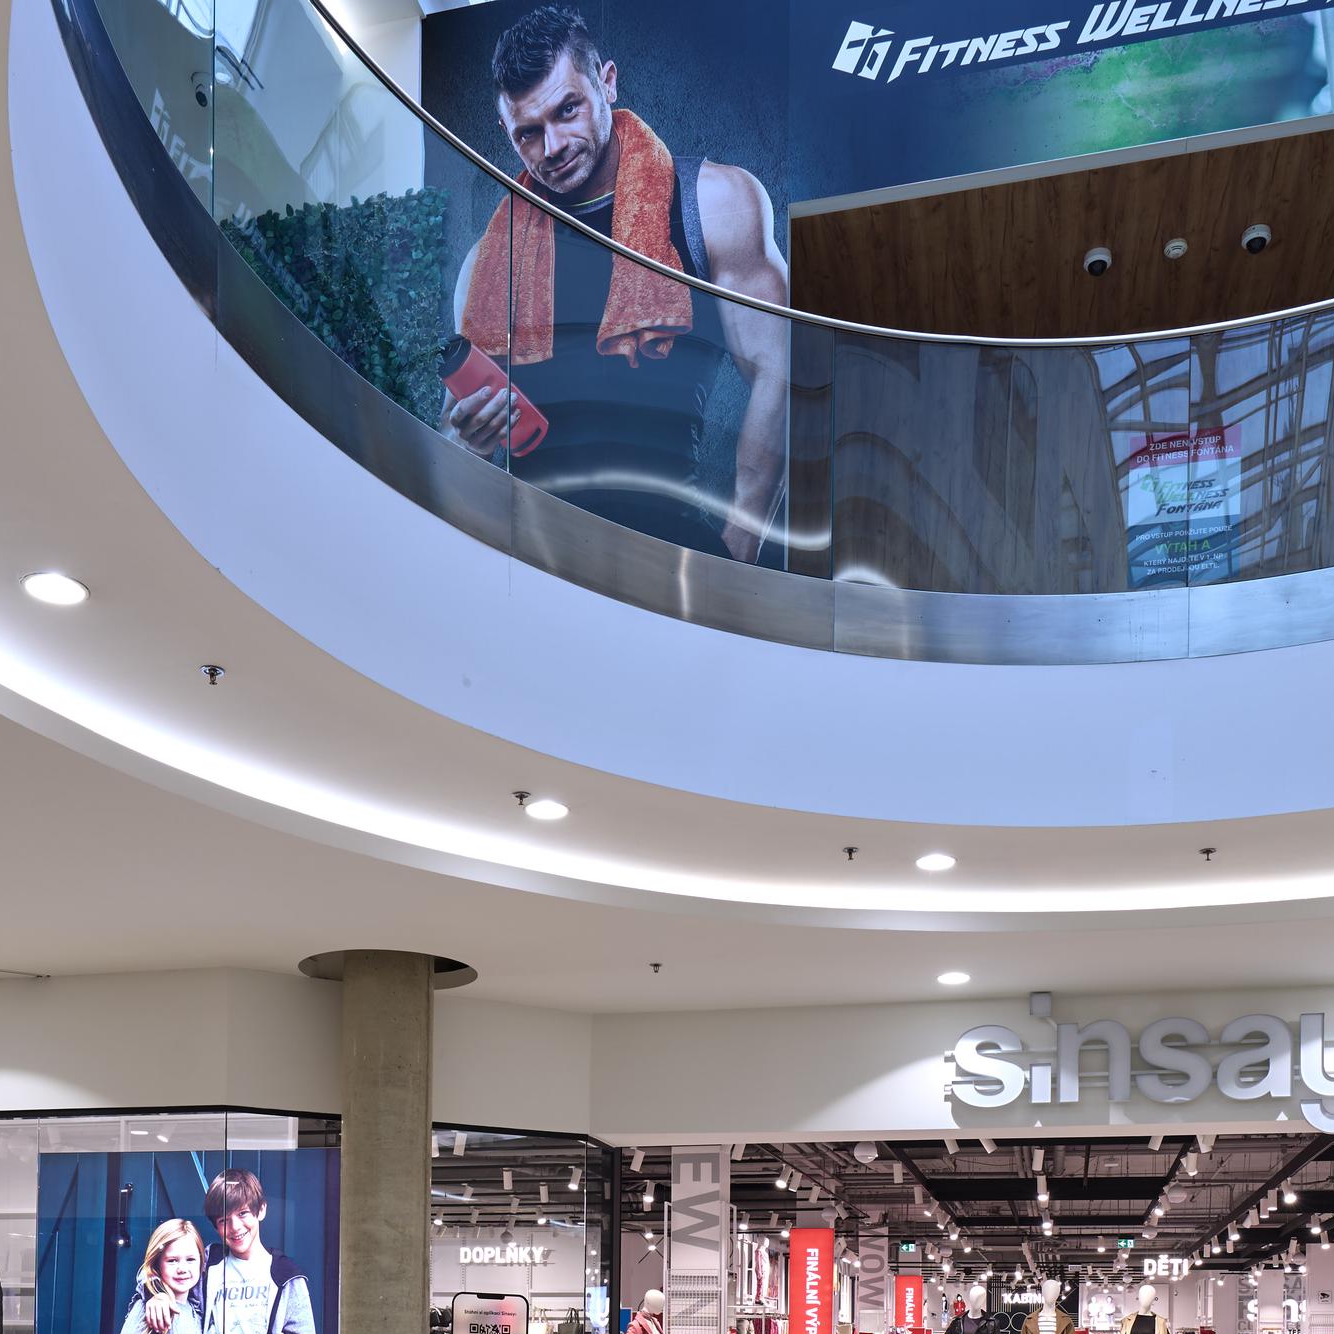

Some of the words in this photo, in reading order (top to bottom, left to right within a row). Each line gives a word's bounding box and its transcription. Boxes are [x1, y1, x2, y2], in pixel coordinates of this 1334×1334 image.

[1149, 441, 1168, 451] ZDE
[1193, 435, 1221, 446] VSTUP
[1136, 455, 1150, 464] DO
[1151, 450, 1188, 462] FITNESS
[1201, 539, 1211, 550] A
[459, 1241, 545, 1264] DOPLŇKY
[1143, 1254, 1189, 1276] DĚTI
[805, 1248, 821, 1306] FINÁLNÍ
